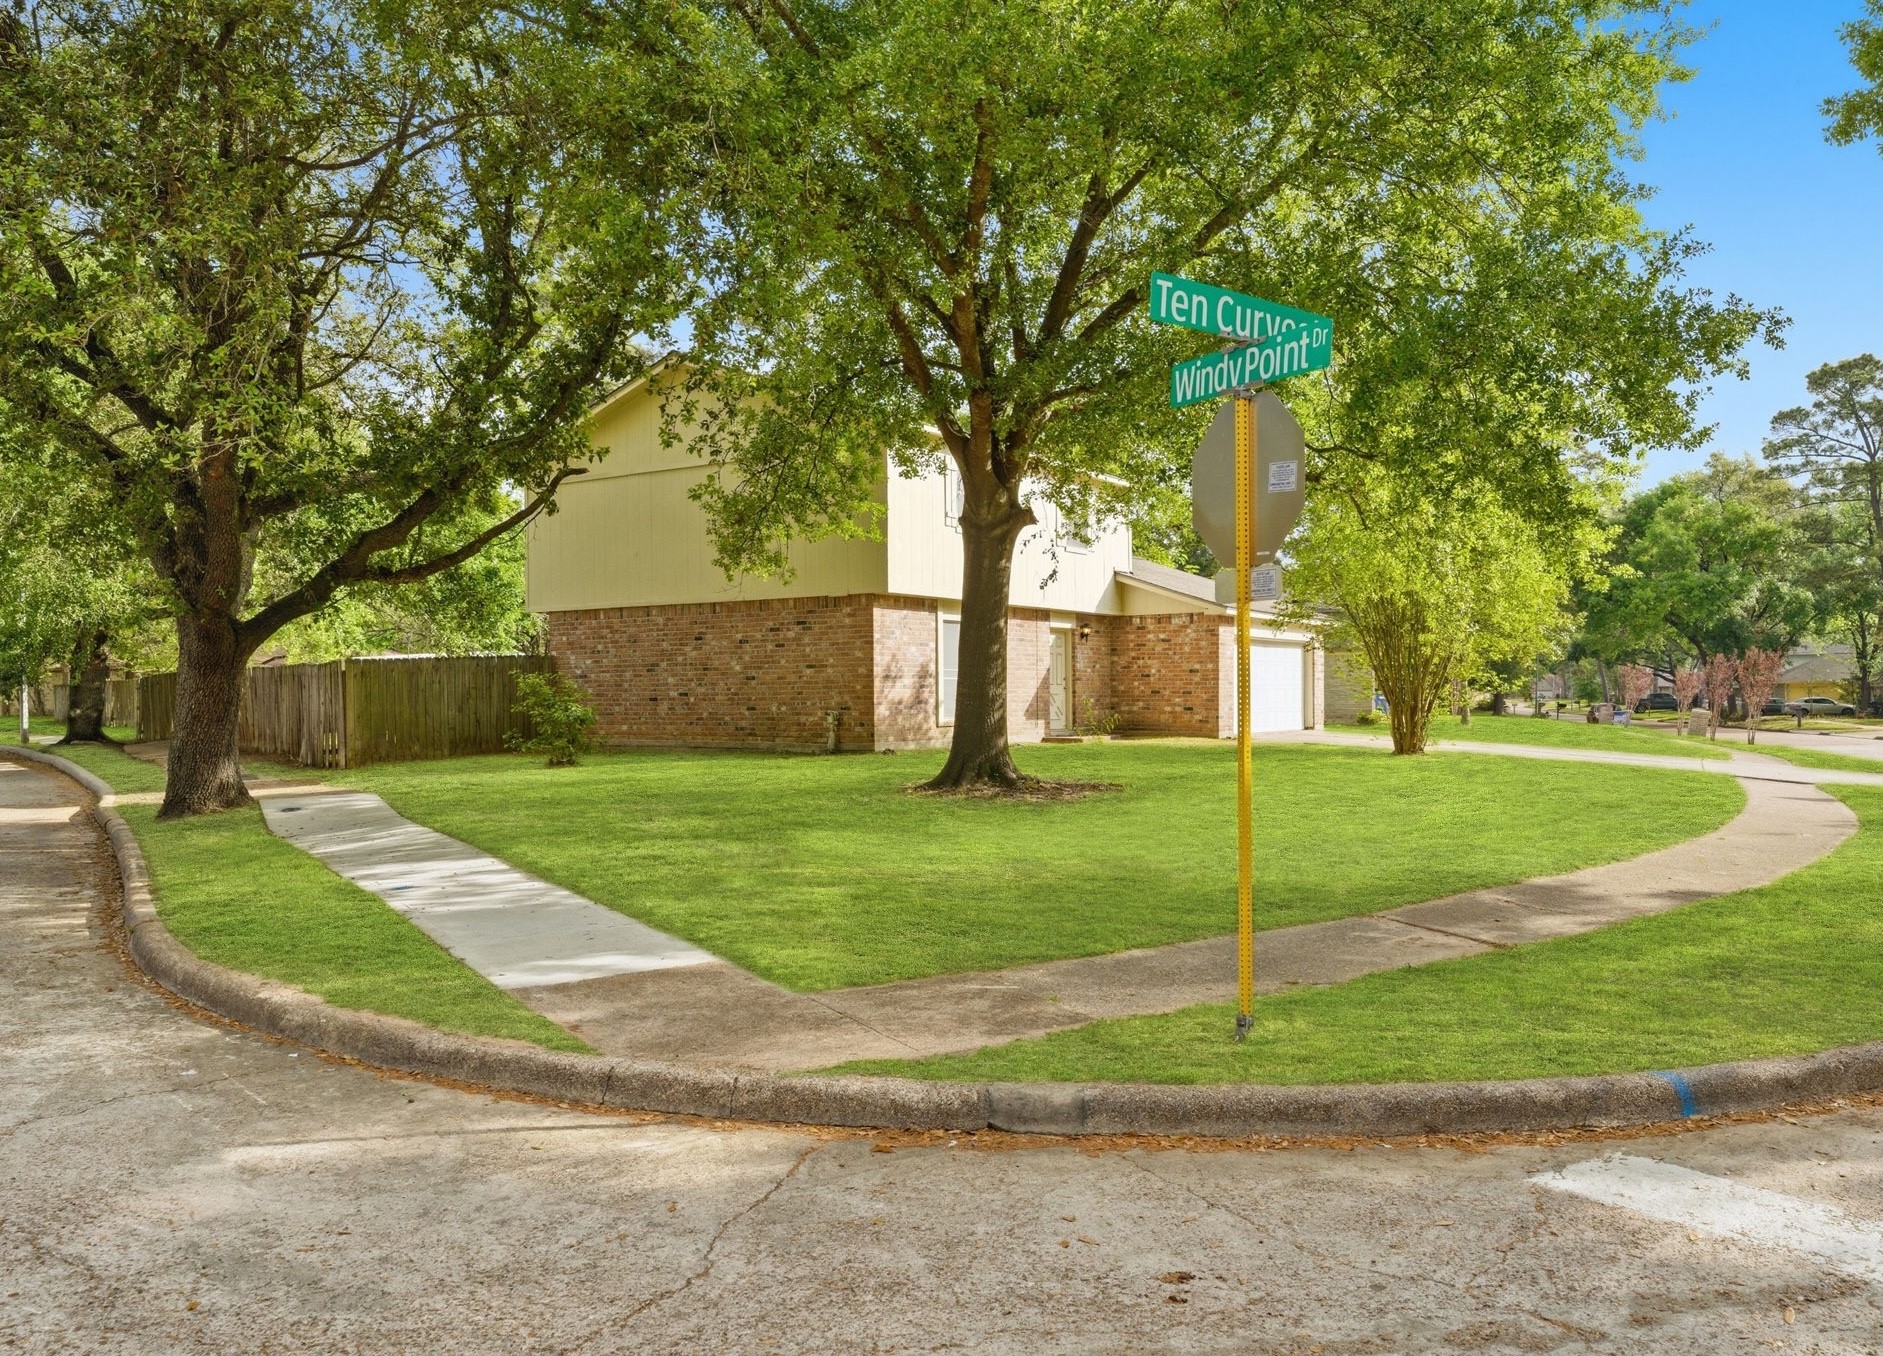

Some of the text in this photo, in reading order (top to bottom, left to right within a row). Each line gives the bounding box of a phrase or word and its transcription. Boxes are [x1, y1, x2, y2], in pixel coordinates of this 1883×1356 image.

[1156, 278, 1308, 338] Ten Curv
[1175, 327, 1329, 403] Windy Point Dr
